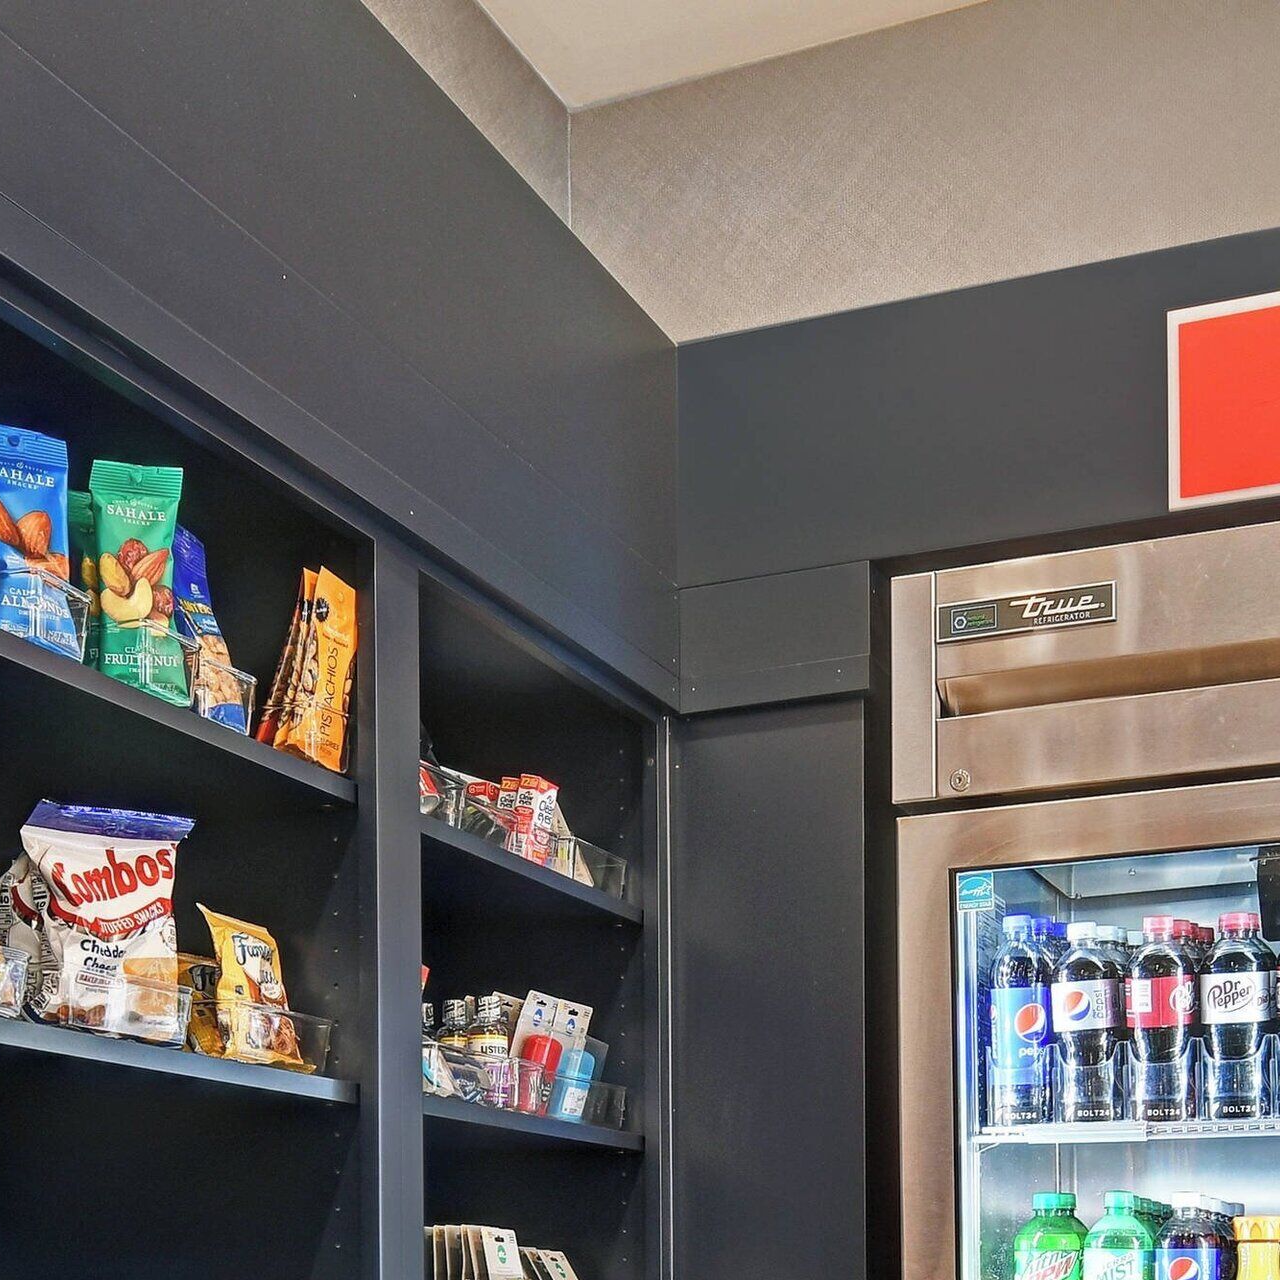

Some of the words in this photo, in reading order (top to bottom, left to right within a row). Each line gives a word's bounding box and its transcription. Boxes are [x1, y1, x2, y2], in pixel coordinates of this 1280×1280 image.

[107, 505, 167, 522] SAHALE
[1033, 611, 1091, 625] REFRIGERATOR
[51, 848, 174, 907] Combos
[1222, 980, 1241, 993] Dr
[1208, 984, 1253, 1011] Pepper
[480, 1044, 506, 1056] LISTER
[1077, 1109, 1110, 1118] BOLT24
[1147, 1108, 1180, 1117] BOLT24
[1223, 1104, 1256, 1113] BOLT24
